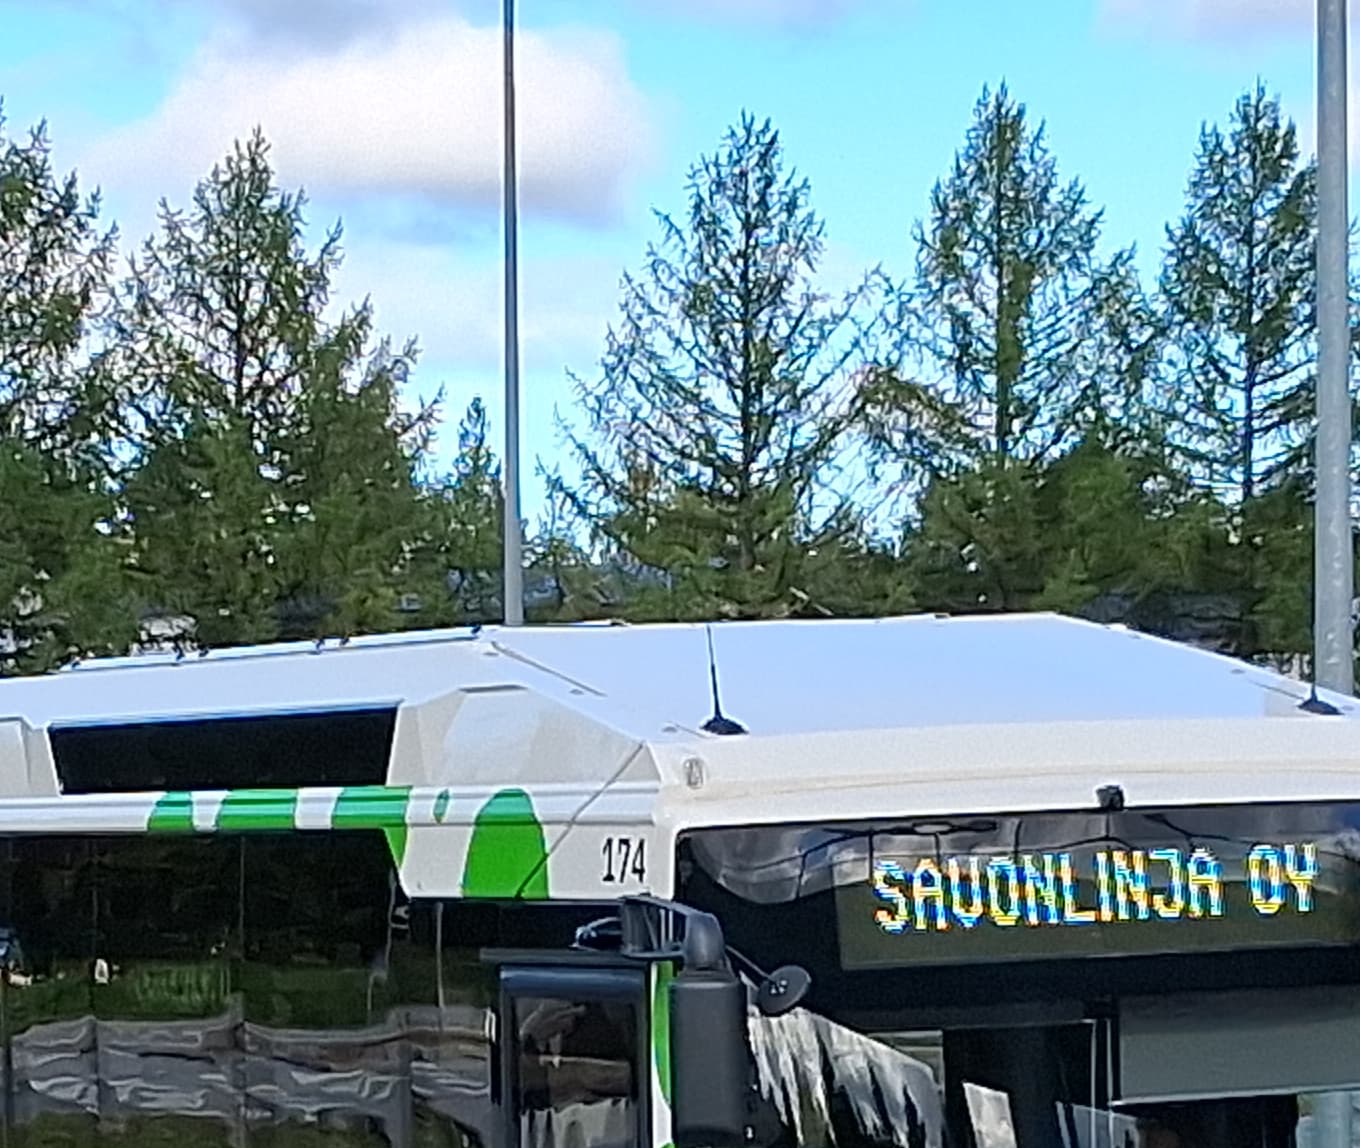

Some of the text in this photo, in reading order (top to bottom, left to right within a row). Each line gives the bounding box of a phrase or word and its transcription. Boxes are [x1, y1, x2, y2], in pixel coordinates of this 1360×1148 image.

[603, 837, 645, 883] 174
[872, 842, 1317, 934] SAVONLINJA OY
